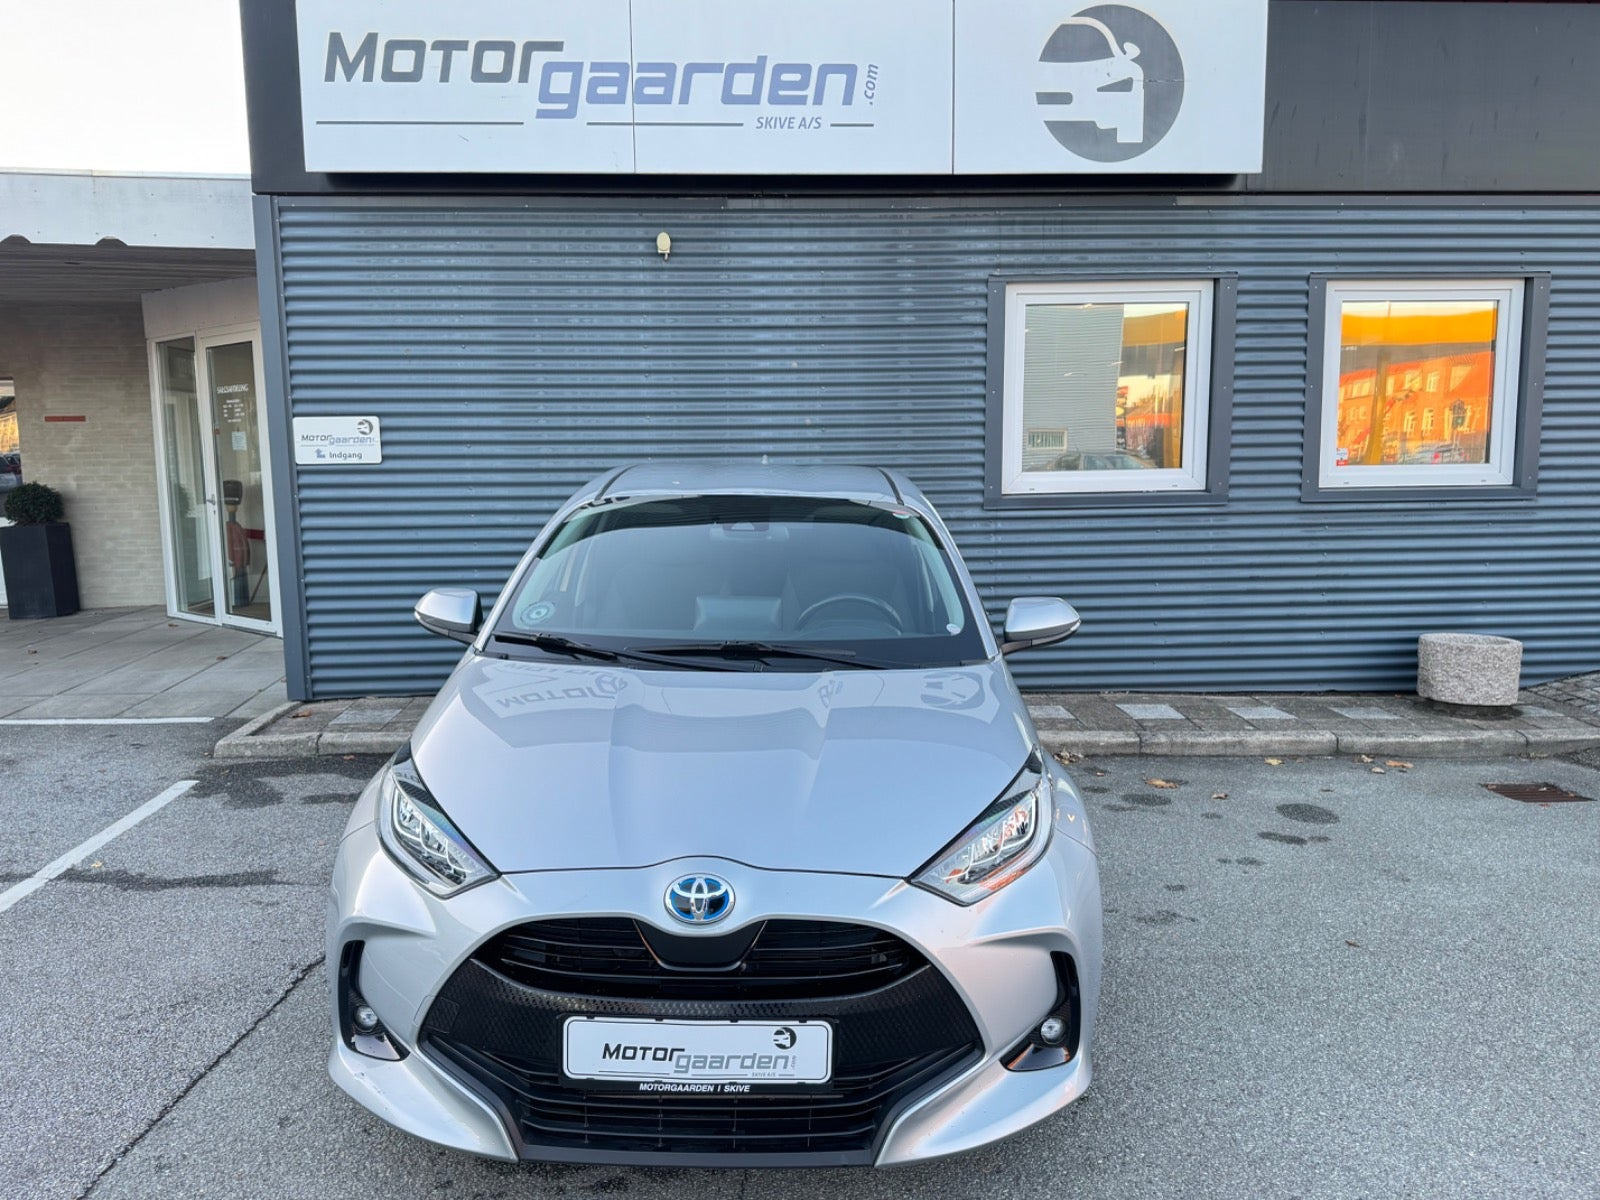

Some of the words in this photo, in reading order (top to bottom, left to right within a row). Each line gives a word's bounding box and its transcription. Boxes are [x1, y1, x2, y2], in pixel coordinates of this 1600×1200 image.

[536, 55, 858, 119] gaarden
[863, 63, 879, 106] .com
[756, 116, 796, 130] SKIVE
[798, 116, 822, 130] A/S
[329, 451, 363, 460] Indgang
[674, 1053, 790, 1074] gaarden
[639, 1083, 714, 1092] MOTORGAARDEN
[723, 1084, 751, 1092] SKIVE
